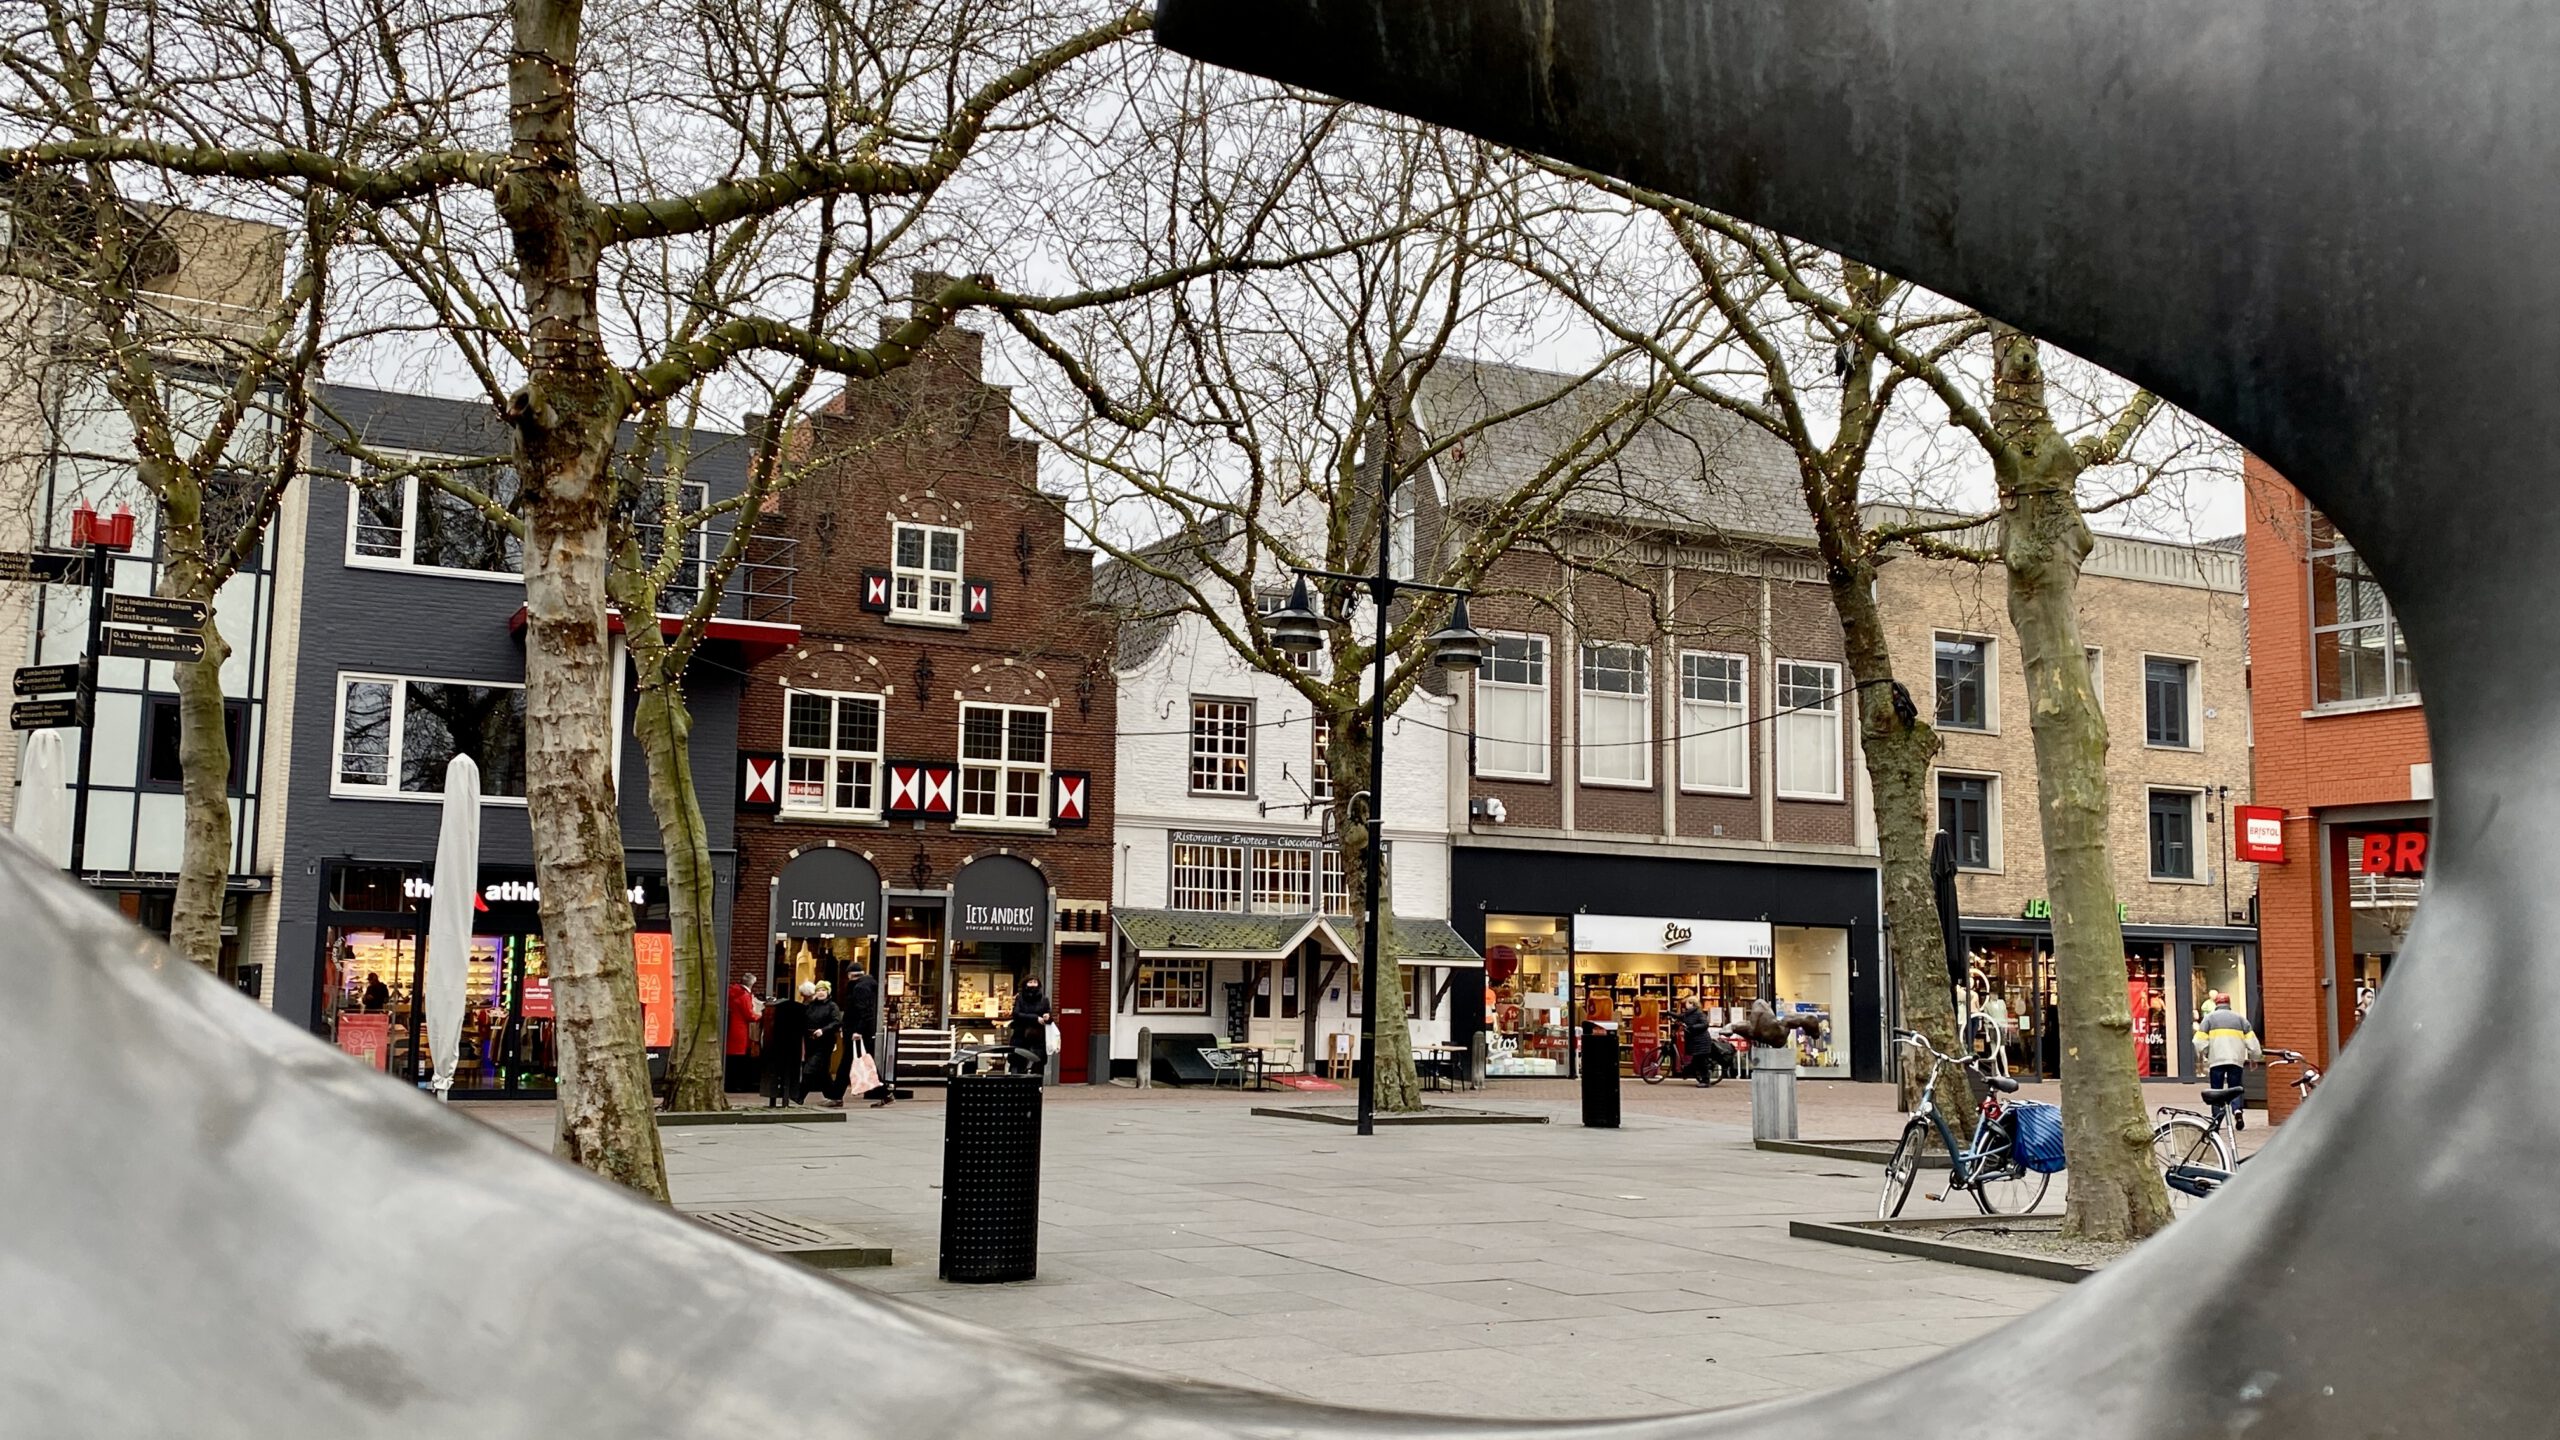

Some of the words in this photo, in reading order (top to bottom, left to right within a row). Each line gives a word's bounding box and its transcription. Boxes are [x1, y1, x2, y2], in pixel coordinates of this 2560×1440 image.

[115, 604, 136, 613] Scala
[129, 598, 167, 609] Industrieel
[168, 603, 192, 611] Atrium
[114, 612, 168, 623] Kunstkwartier
[129, 632, 175, 643] Vrouwekerk
[113, 639, 140, 648] Theater
[2250, 826, 2279, 837] BRISTOL
[1173, 831, 1222, 843] Ristorante
[1232, 834, 1268, 846] Enoteca
[2362, 832, 2426, 873] BR
[831, 921, 864, 929] lifestyle
[1003, 925, 1033, 933] lifestyle
[1664, 922, 1692, 944] Etos
[1749, 944, 1771, 956] 1919
[1488, 1033, 1518, 1052] Etos
[2145, 1034, 2164, 1045] 60%
